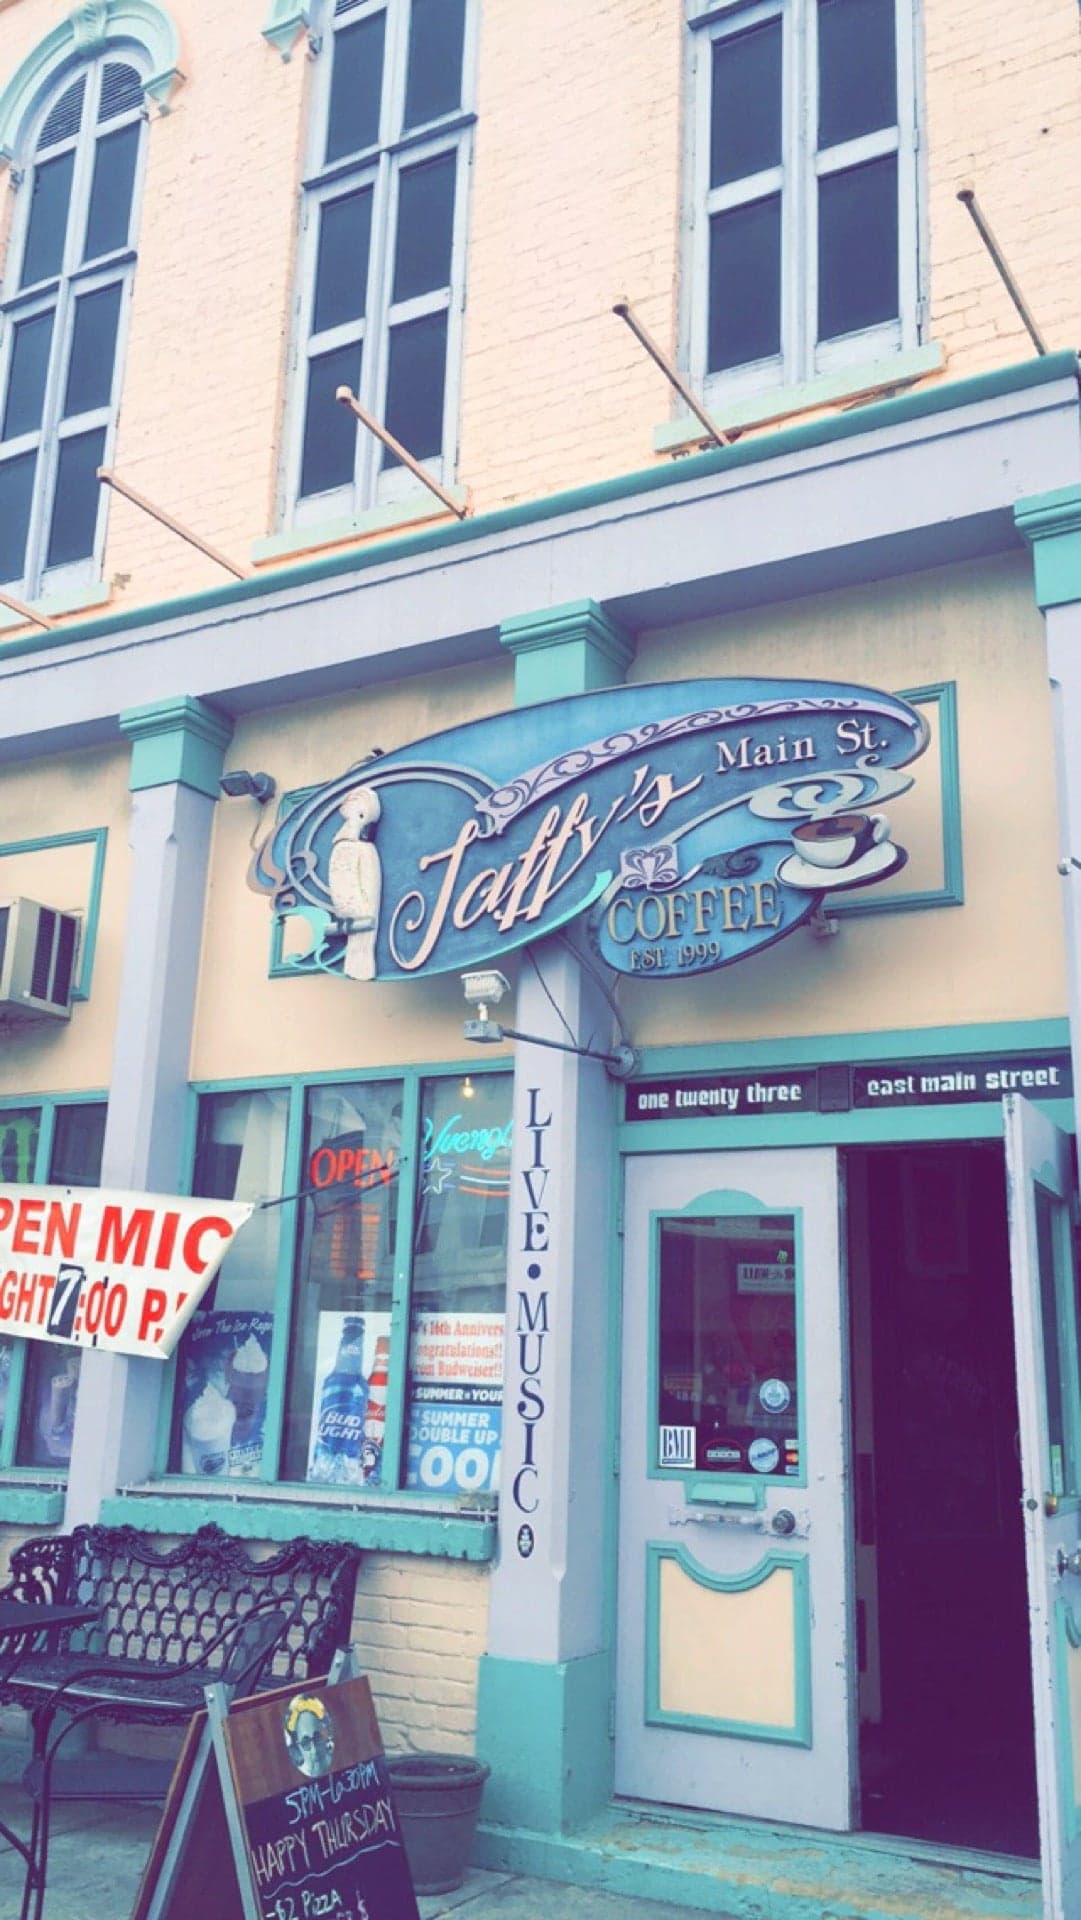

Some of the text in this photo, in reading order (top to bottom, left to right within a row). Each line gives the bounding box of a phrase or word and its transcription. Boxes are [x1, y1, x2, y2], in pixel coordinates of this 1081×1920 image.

[715, 719, 889, 774] Main St.
[608, 880, 782, 944] COFFEE
[677, 941, 720, 967] 1999
[638, 1083, 801, 1111] one twenty three
[867, 1067, 1060, 1096] east main street
[309, 1147, 395, 1189] OPEN
[522, 1087, 553, 1252] LIVE
[96, 1206, 234, 1275] MIC
[415, 1387, 464, 1401] SUMMER
[513, 1290, 550, 1514] MUSIC
[422, 1410, 491, 1428] SUMMER
[474, 1430, 499, 1446] UP
[251, 1797, 396, 1886] HAPPY THURSDAY
